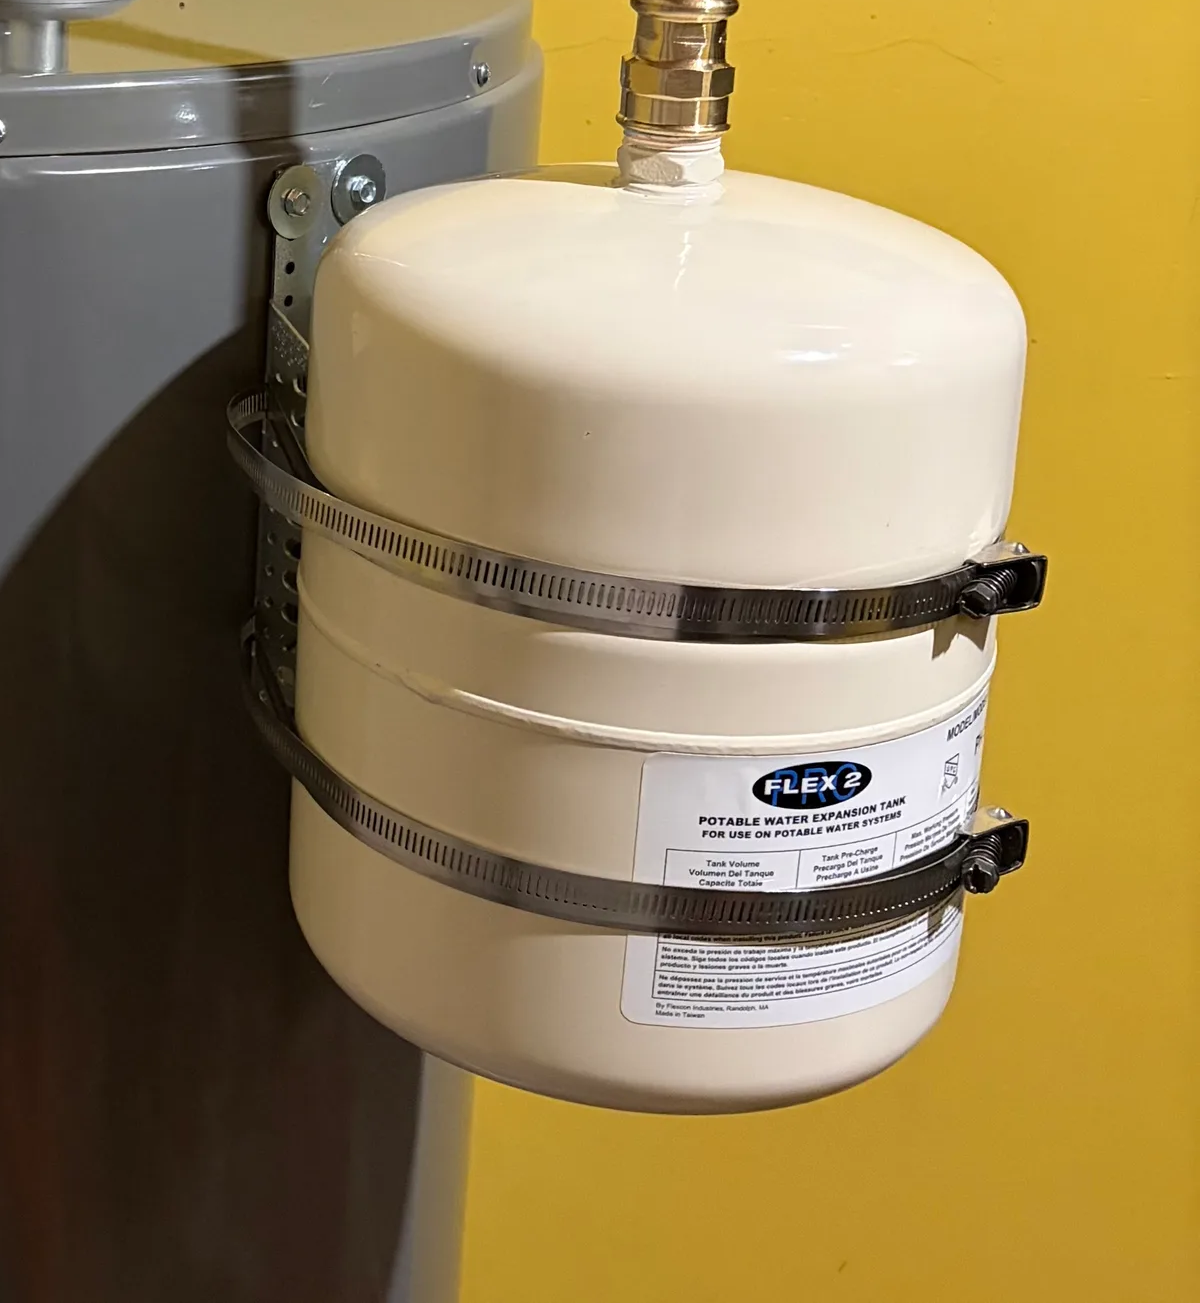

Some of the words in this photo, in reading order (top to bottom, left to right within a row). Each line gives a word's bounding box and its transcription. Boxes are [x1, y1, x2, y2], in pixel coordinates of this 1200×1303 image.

[764, 774, 837, 796] FLEX
[843, 771, 862, 789] 2
[699, 815, 760, 827] POTABLE
[764, 814, 809, 827] WATER
[812, 803, 877, 823] EXPANSION
[880, 796, 906, 812] TANK
[702, 829, 725, 840] FOR
[729, 831, 752, 840] USE
[755, 830, 771, 840] ON
[774, 826, 823, 839] POTABLE
[826, 820, 860, 834] WATER
[862, 810, 901, 828] SYSTEMS
[822, 853, 839, 863] Tank
[706, 860, 727, 868] Tank
[729, 860, 760, 868] Volume
[847, 859, 858, 869] Del
[689, 868, 726, 879] Volumen
[728, 870, 742, 879] Del
[745, 869, 774, 879] Tanque
